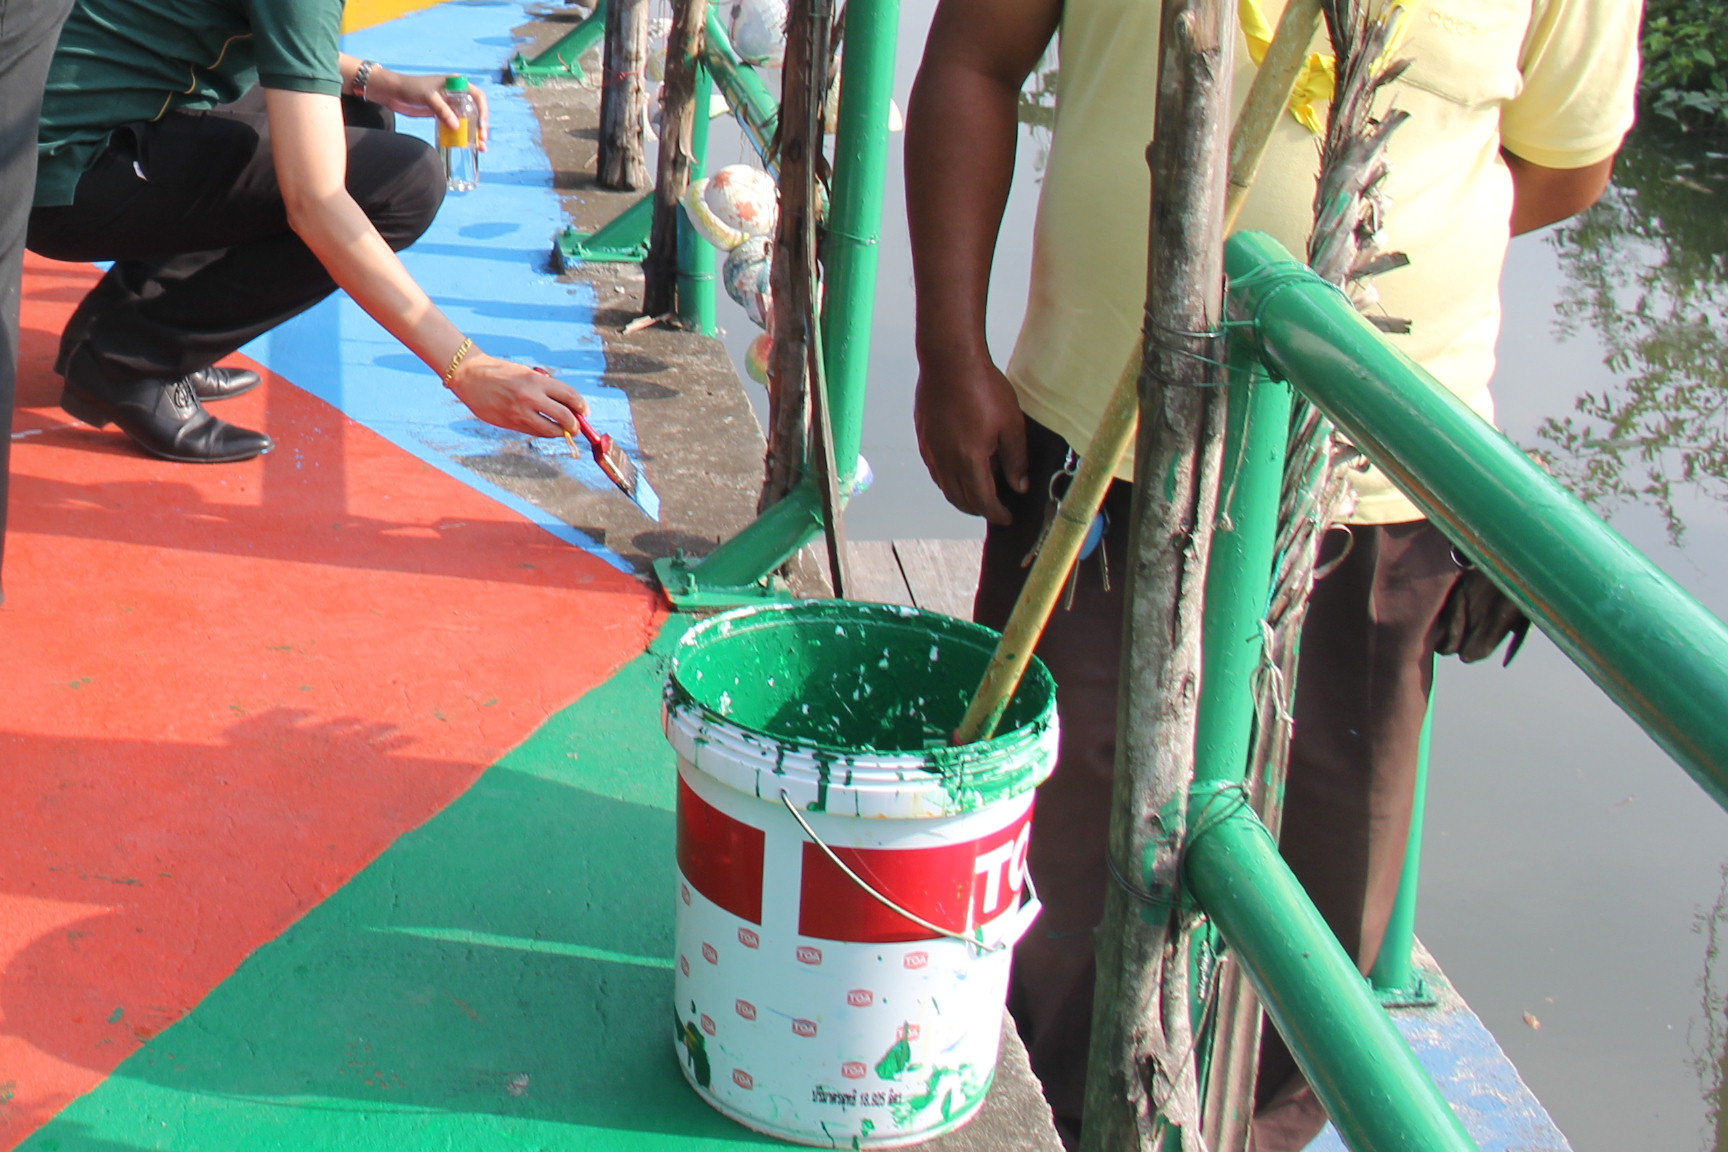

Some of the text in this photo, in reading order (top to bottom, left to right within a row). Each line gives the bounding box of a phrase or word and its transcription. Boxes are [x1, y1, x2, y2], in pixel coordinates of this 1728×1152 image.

[739, 930, 758, 947] TOA
[797, 948, 821, 963] TOA
[905, 954, 927, 968] TOA
[848, 991, 872, 1005] TOA
[736, 1002, 756, 1019] TOA
[793, 1021, 816, 1035] TOA
[843, 1063, 866, 1077] TOA
[733, 1071, 752, 1088] TOA
